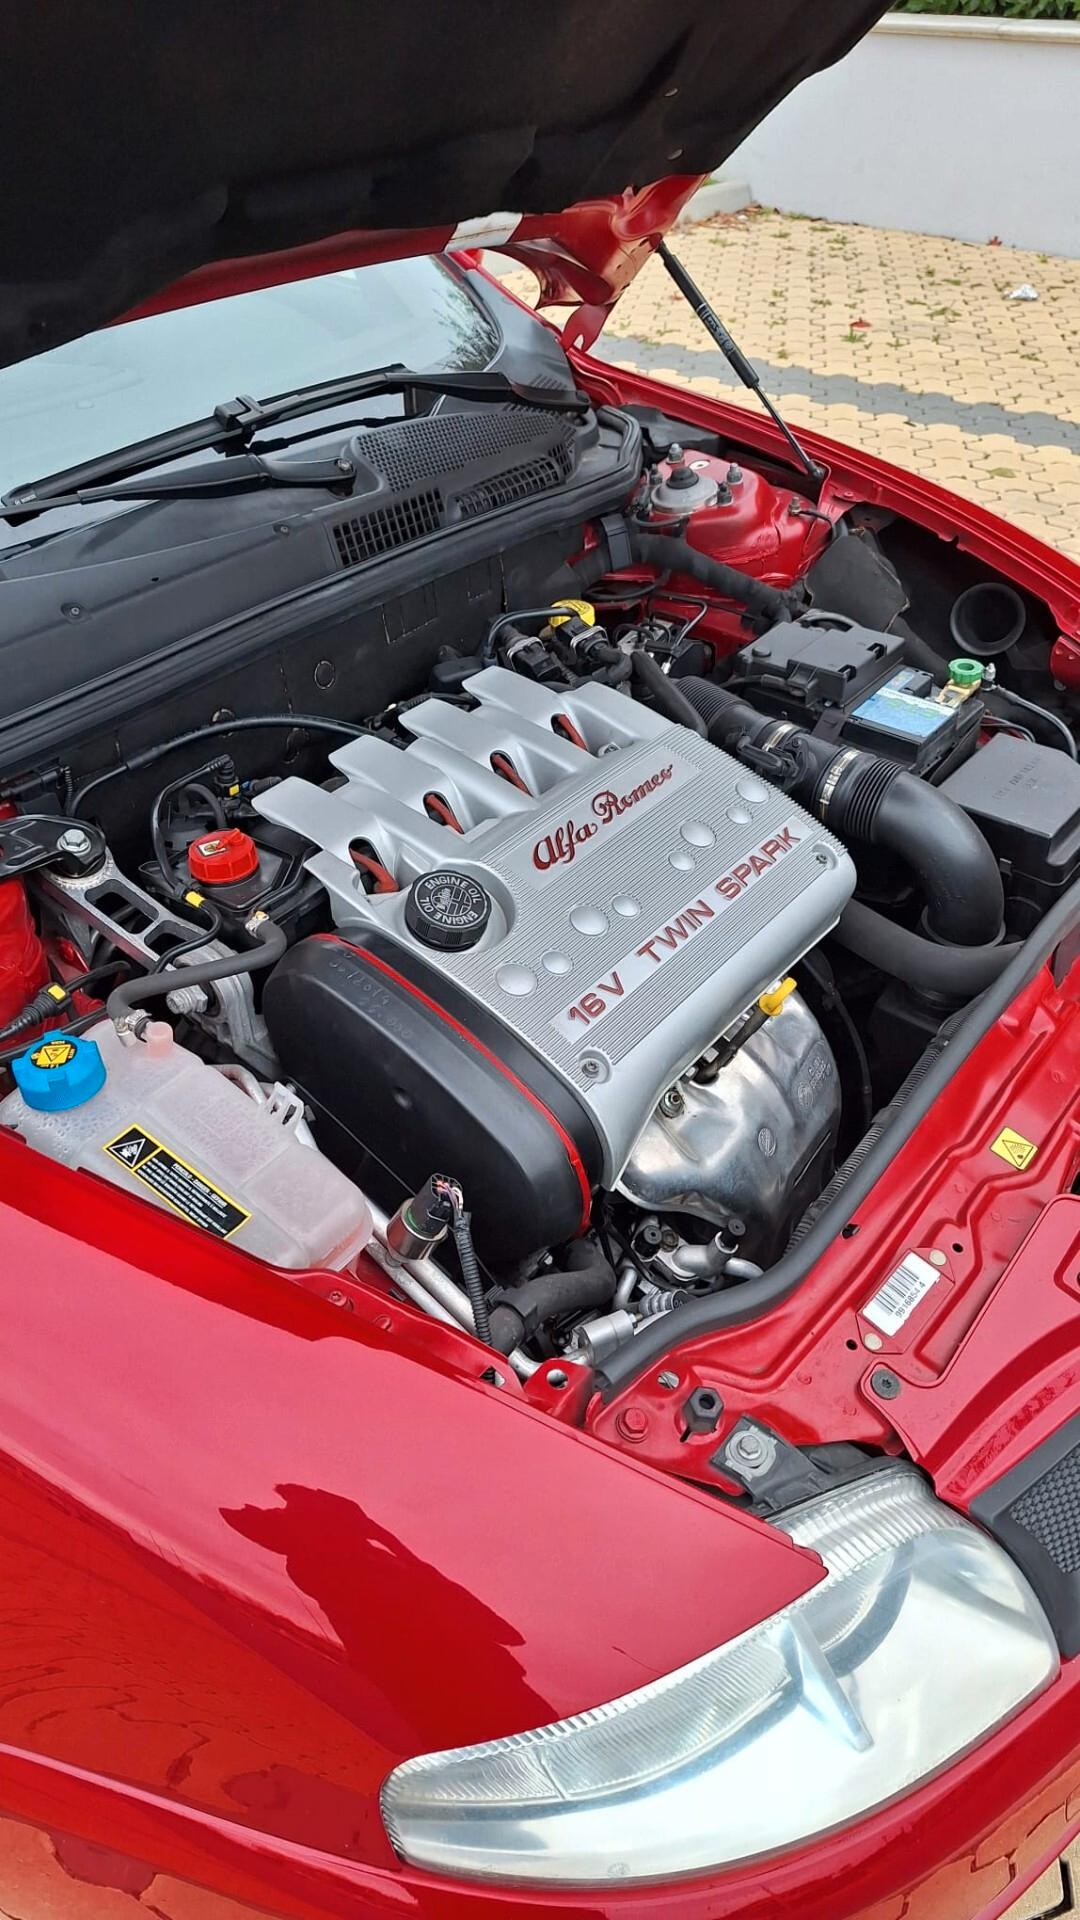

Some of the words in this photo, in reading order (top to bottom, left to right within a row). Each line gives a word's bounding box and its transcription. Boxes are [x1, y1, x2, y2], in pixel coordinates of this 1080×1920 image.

[532, 819, 598, 871] Alfa
[591, 763, 674, 824] Romeo
[424, 875, 469, 890] ENGINE
[468, 887, 483, 904] OIL
[419, 896, 434, 913] OIL
[433, 910, 479, 926] ENGINE
[567, 971, 625, 1026] 16V
[634, 898, 716, 963] TWIN
[714, 826, 801, 901] SPARK
